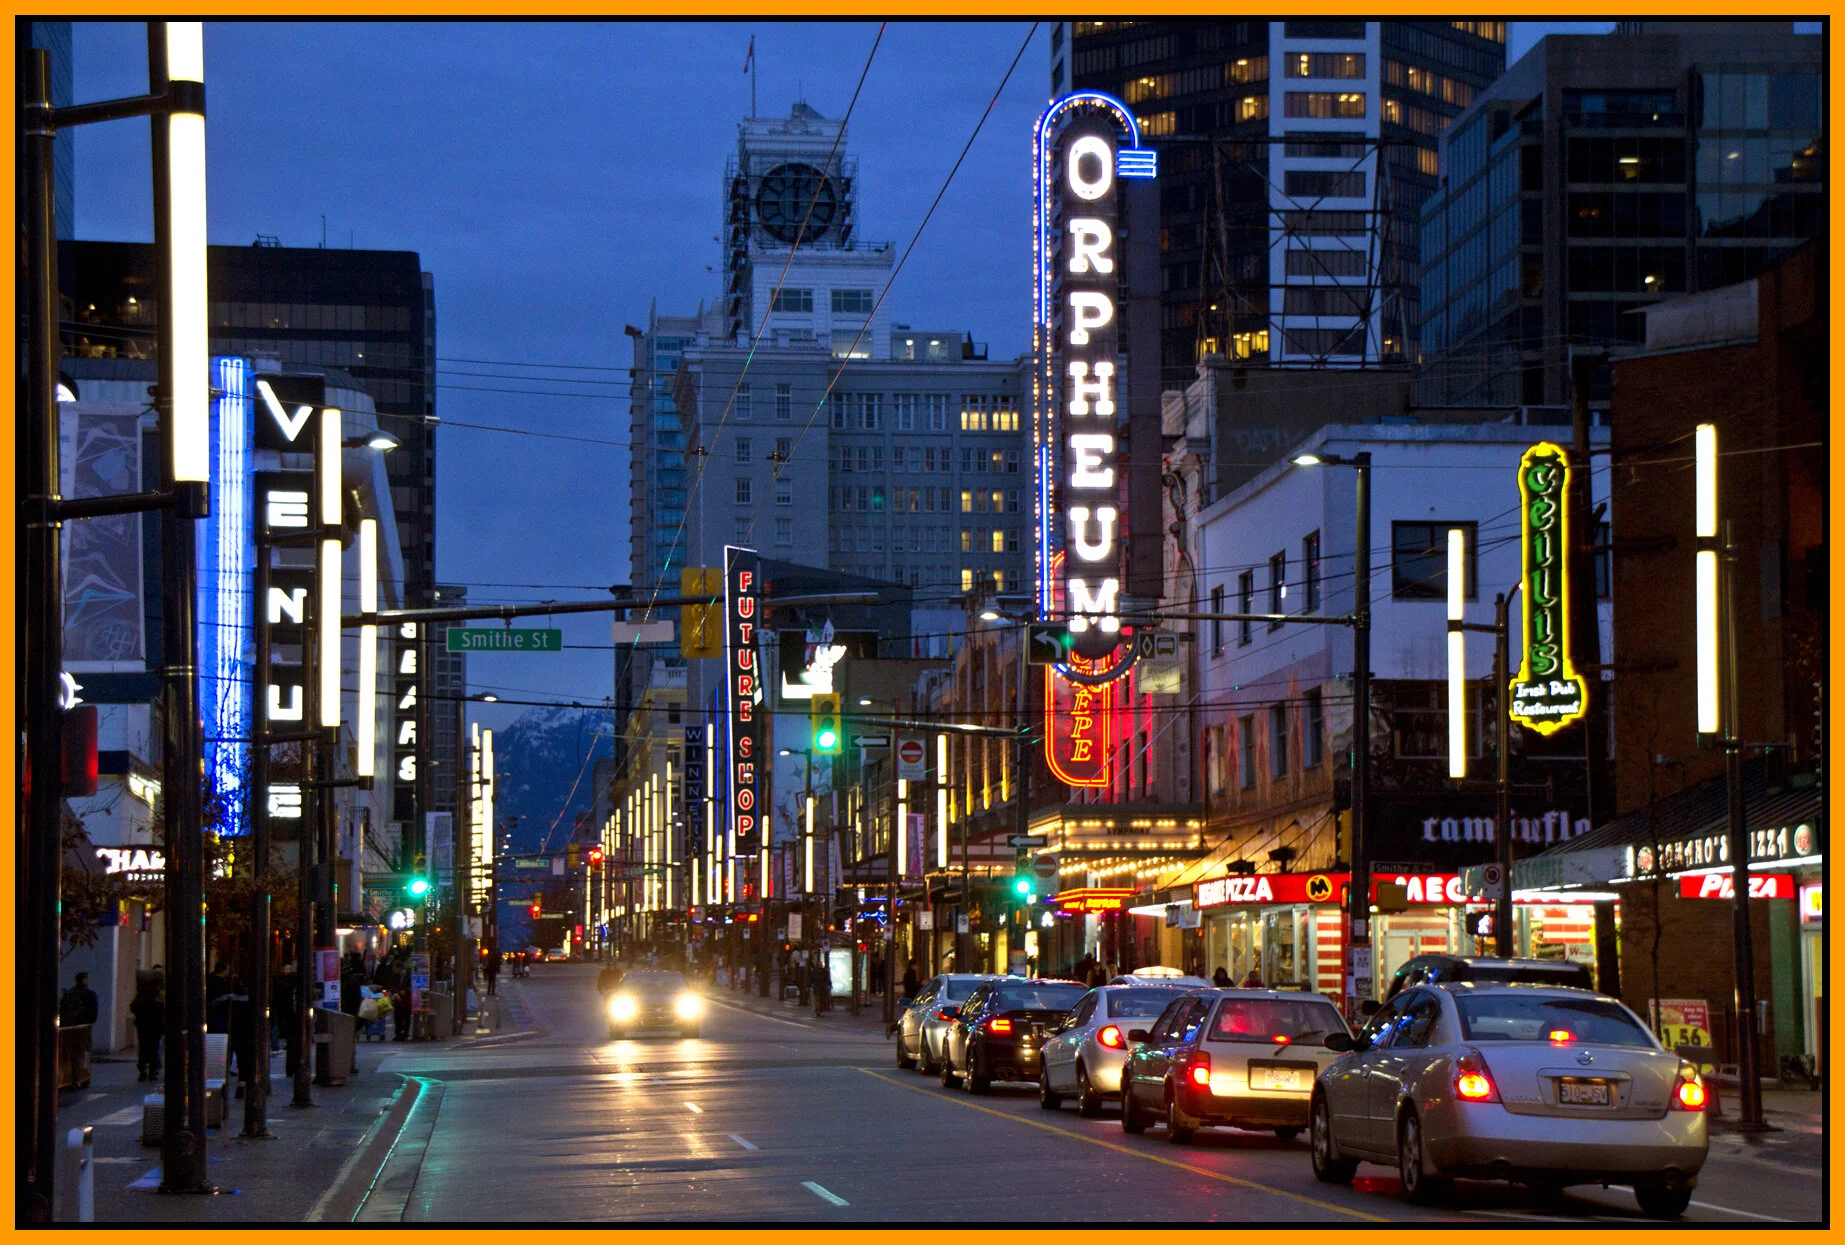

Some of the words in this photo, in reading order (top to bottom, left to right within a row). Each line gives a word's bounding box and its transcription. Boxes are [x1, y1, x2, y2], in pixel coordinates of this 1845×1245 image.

[1067, 135, 1120, 633] ORPHEUM
[256, 379, 314, 819] VENUE
[461, 630, 524, 648] Smithe
[532, 631, 549, 648] St
[738, 570, 753, 722] FUTURE
[1549, 681, 1575, 696] Pub
[738, 736, 754, 836] SHOP
[1225, 876, 1274, 902] PIZZA
[1662, 1027, 1702, 1048] 1.56
